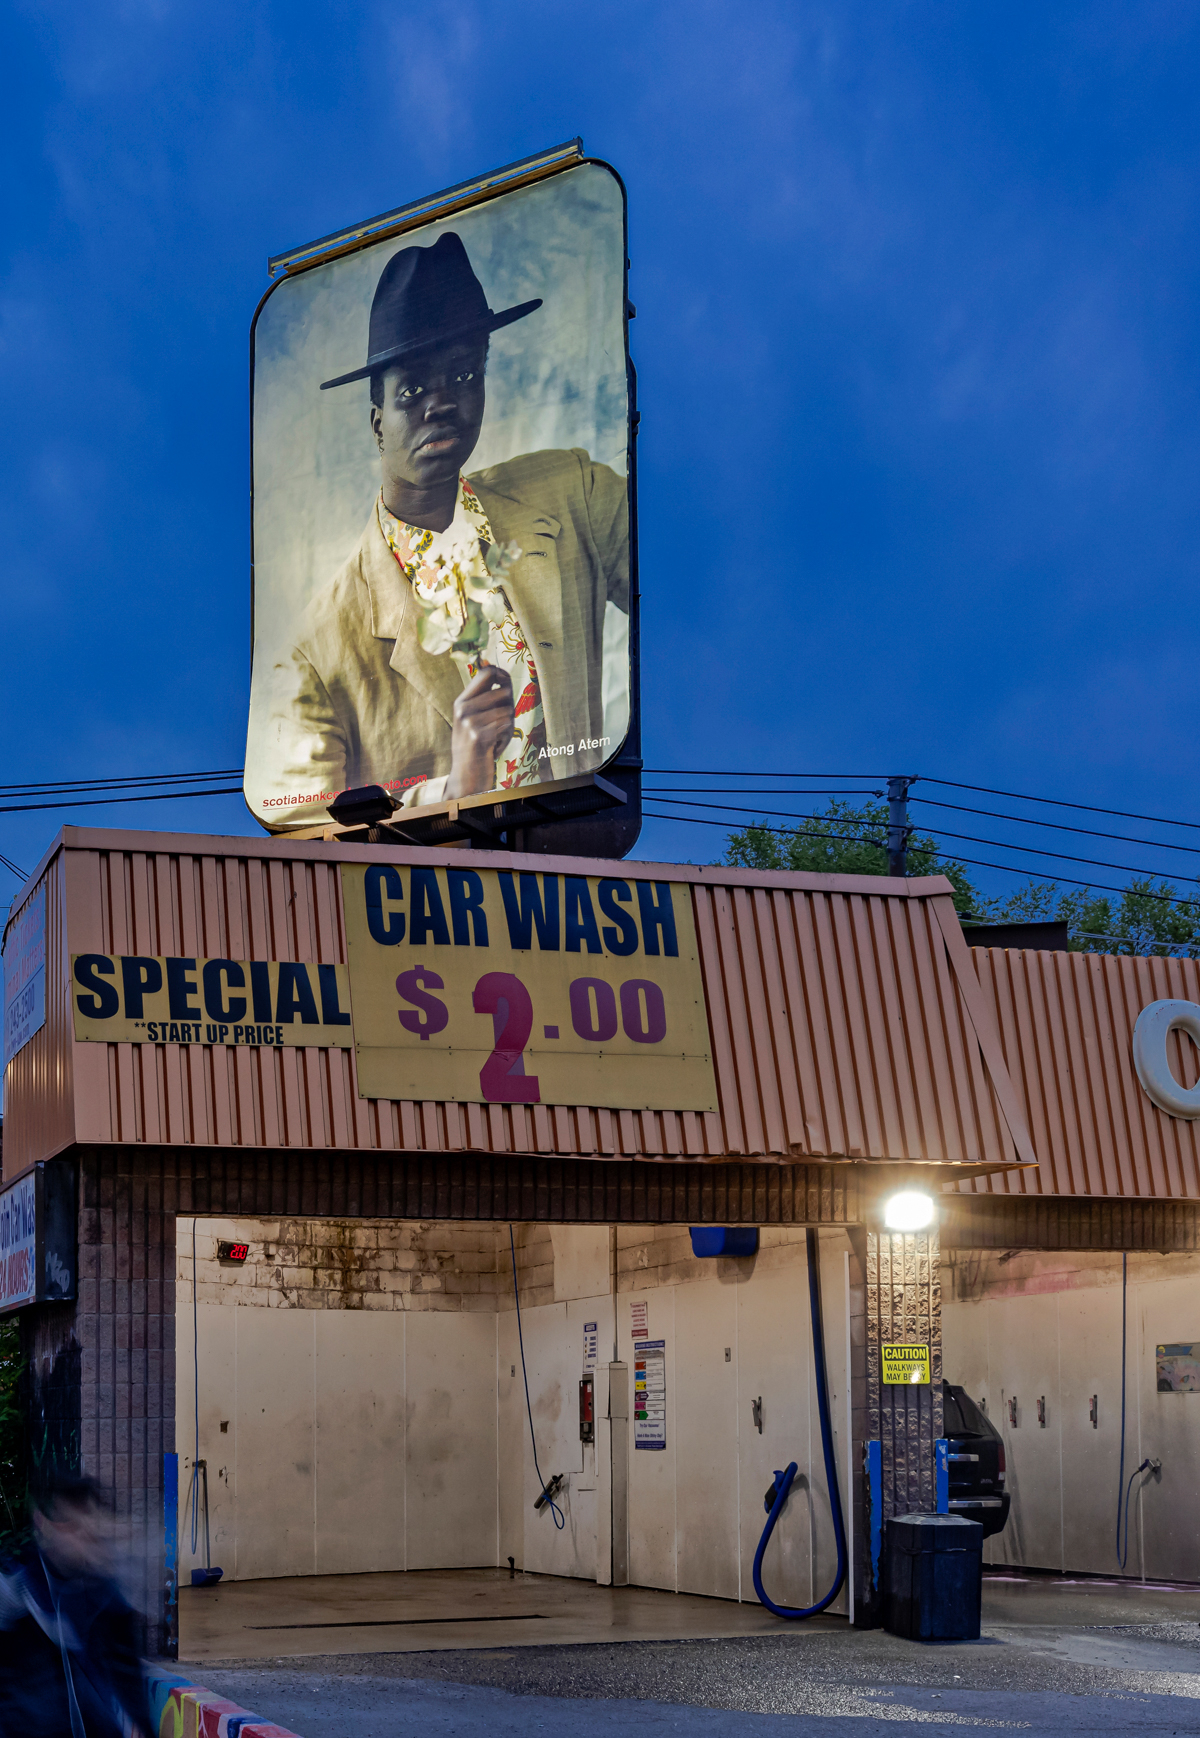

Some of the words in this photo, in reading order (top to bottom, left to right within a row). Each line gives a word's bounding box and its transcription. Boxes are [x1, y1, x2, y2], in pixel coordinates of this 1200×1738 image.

[538, 743, 574, 759] Atong
[578, 737, 610, 751] Atem
[364, 863, 489, 947] CAR
[497, 870, 679, 957] WASH
[74, 954, 351, 1026] SPECIAL
[207, 1023, 228, 1043] UP
[234, 1025, 284, 1045] PRICE
[11, 1194, 20, 1246] Car
[0, 1259, 7, 1301] 24
[7, 1247, 29, 1298] HOURS
[885, 1348, 926, 1359] CAUTION
[886, 1363, 925, 1371] WALKWAYS
